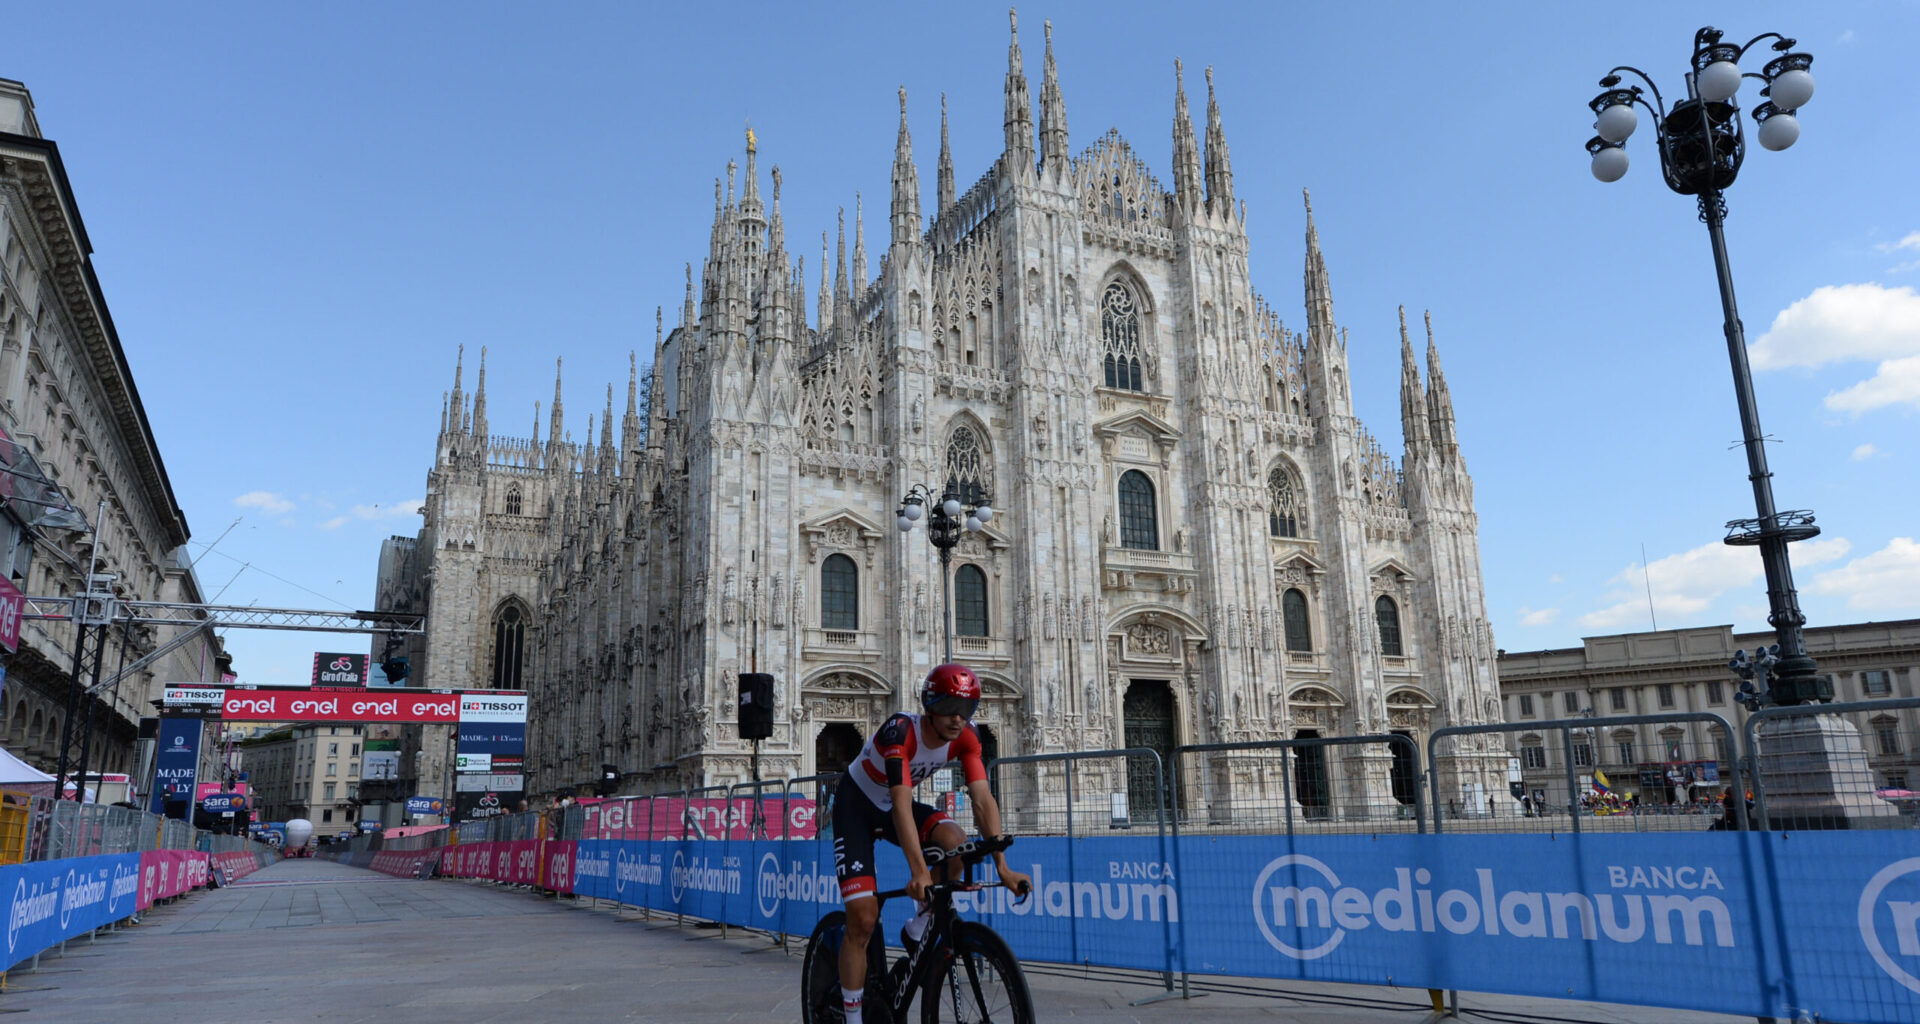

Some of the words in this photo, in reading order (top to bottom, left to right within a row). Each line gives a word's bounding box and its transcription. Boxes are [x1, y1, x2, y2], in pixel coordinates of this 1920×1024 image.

[0, 596, 18, 641] nel
[321, 671, 336, 682] Giro
[185, 691, 223, 699] TISSOT
[226, 697, 276, 713] enel
[291, 698, 338, 715] enel
[352, 698, 398, 716] enel
[412, 700, 456, 716] enel
[481, 702, 525, 711] TISSOT
[157, 768, 195, 778] MADE
[204, 797, 230, 807] sara
[407, 799, 430, 809] sara
[585, 801, 635, 830] nel
[680, 800, 747, 830] enel
[790, 803, 817, 828] en
[551, 843, 571, 888] enel
[617, 854, 662, 886] mediolanum
[723, 855, 741, 867] BANCA
[1109, 860, 1175, 880] BANCA
[673, 857, 741, 895] mediolanum
[761, 861, 846, 905] mediolan
[1607, 865, 1724, 892] BANCA
[951, 863, 1179, 923] ediolanum
[1271, 865, 1736, 948] mediolanum
[951, 966, 963, 1022] COLNAGO
